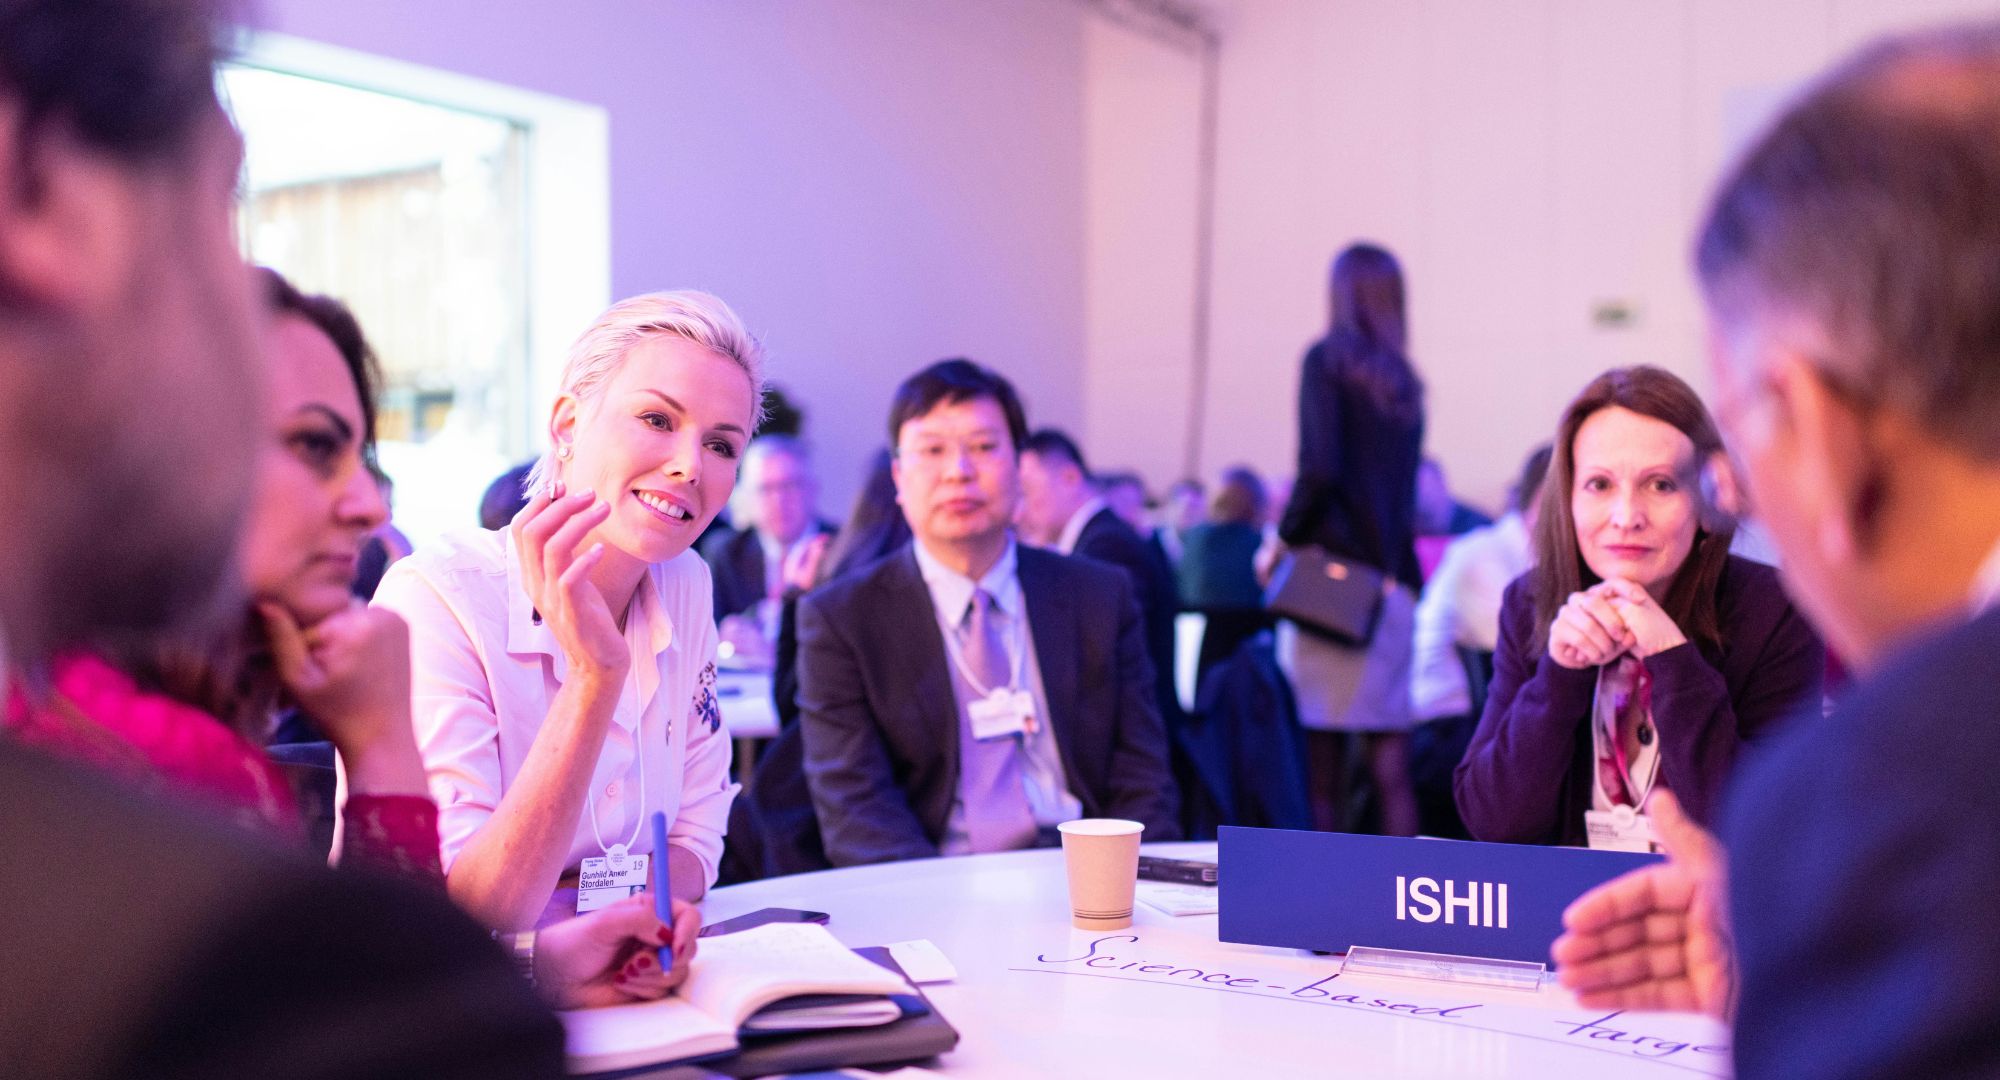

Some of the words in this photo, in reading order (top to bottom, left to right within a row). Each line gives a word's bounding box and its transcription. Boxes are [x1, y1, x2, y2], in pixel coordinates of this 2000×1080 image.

[633, 860, 643, 870] 19
[582, 870, 608, 880] Gunhild
[580, 879, 614, 888] Stordalen
[1396, 876, 1508, 928] ISHII
